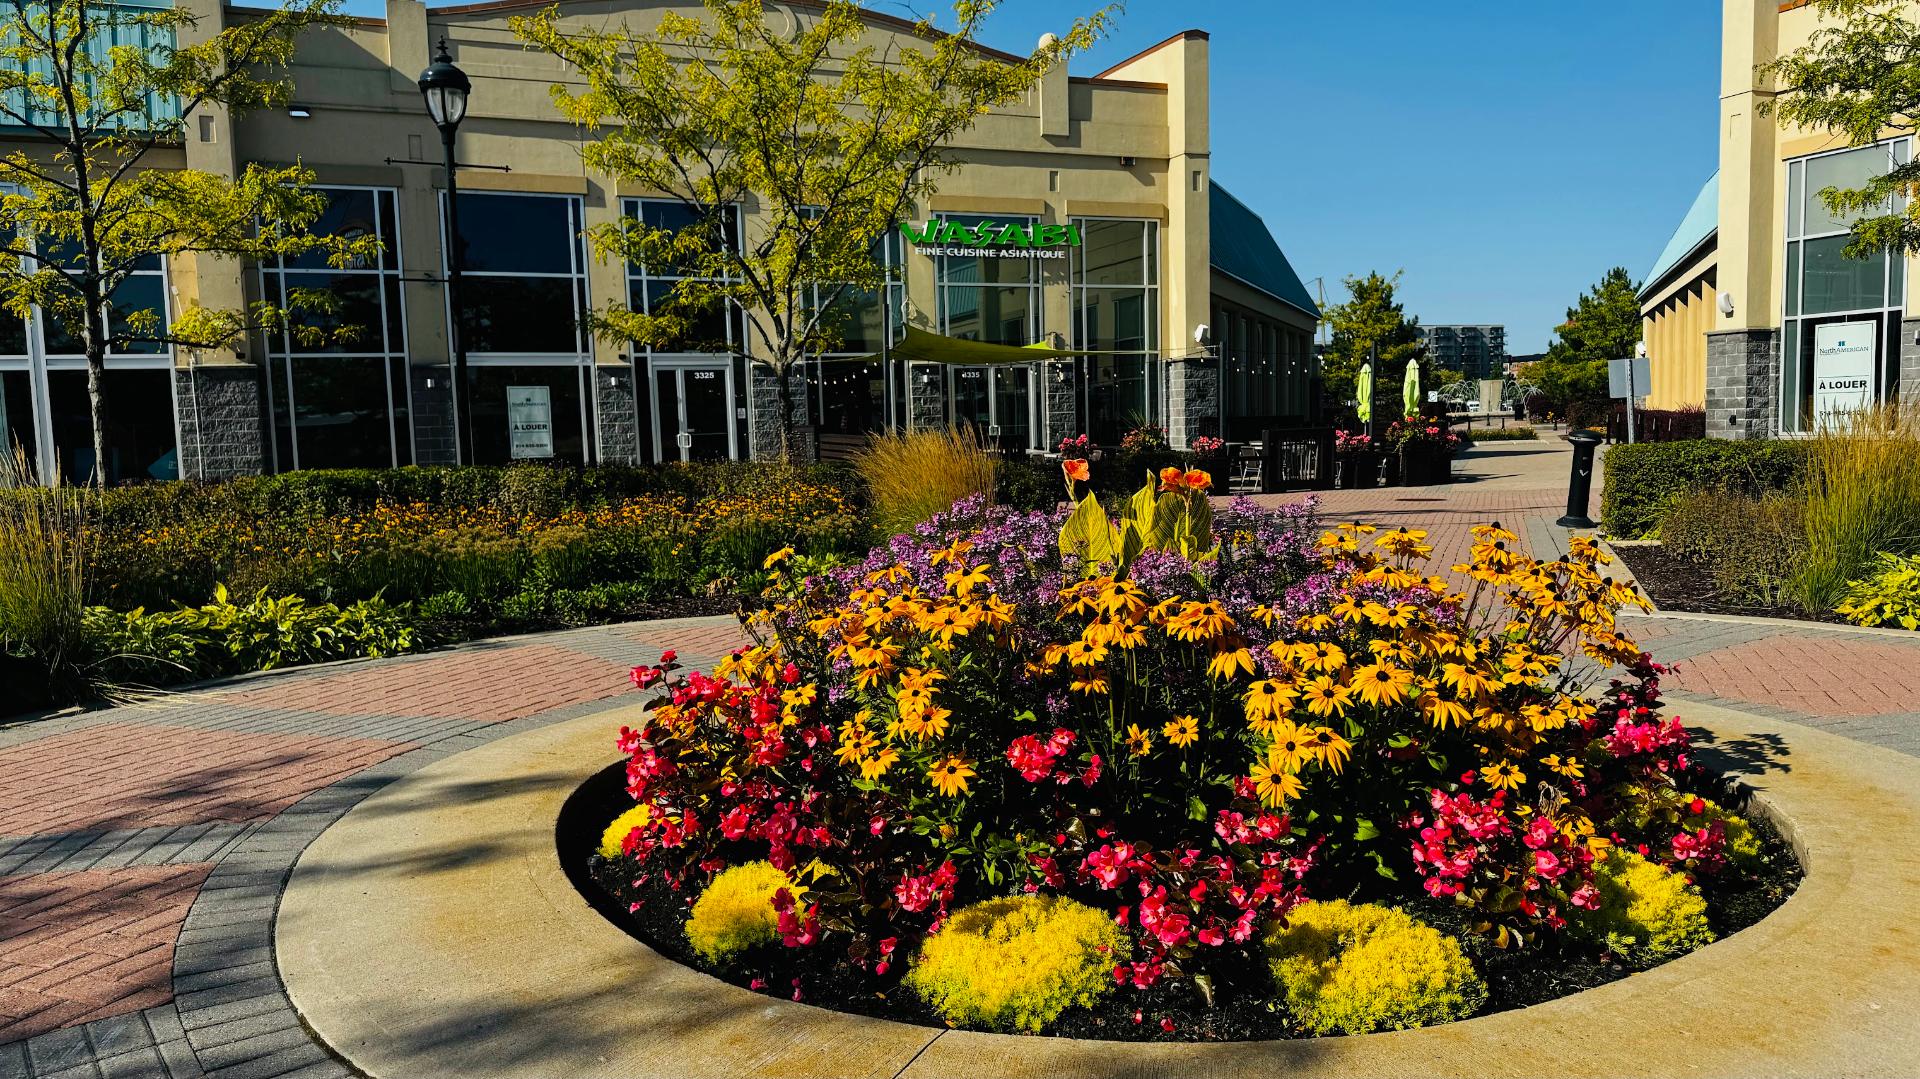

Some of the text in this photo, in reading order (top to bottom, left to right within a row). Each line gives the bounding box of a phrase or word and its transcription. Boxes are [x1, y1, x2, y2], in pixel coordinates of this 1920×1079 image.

[900, 219, 1081, 247] WASABI
[914, 247, 1065, 259] FINE CUISINE ASIATIQUE
[694, 371, 715, 379] 3325
[1829, 381, 1868, 389] LOUER
